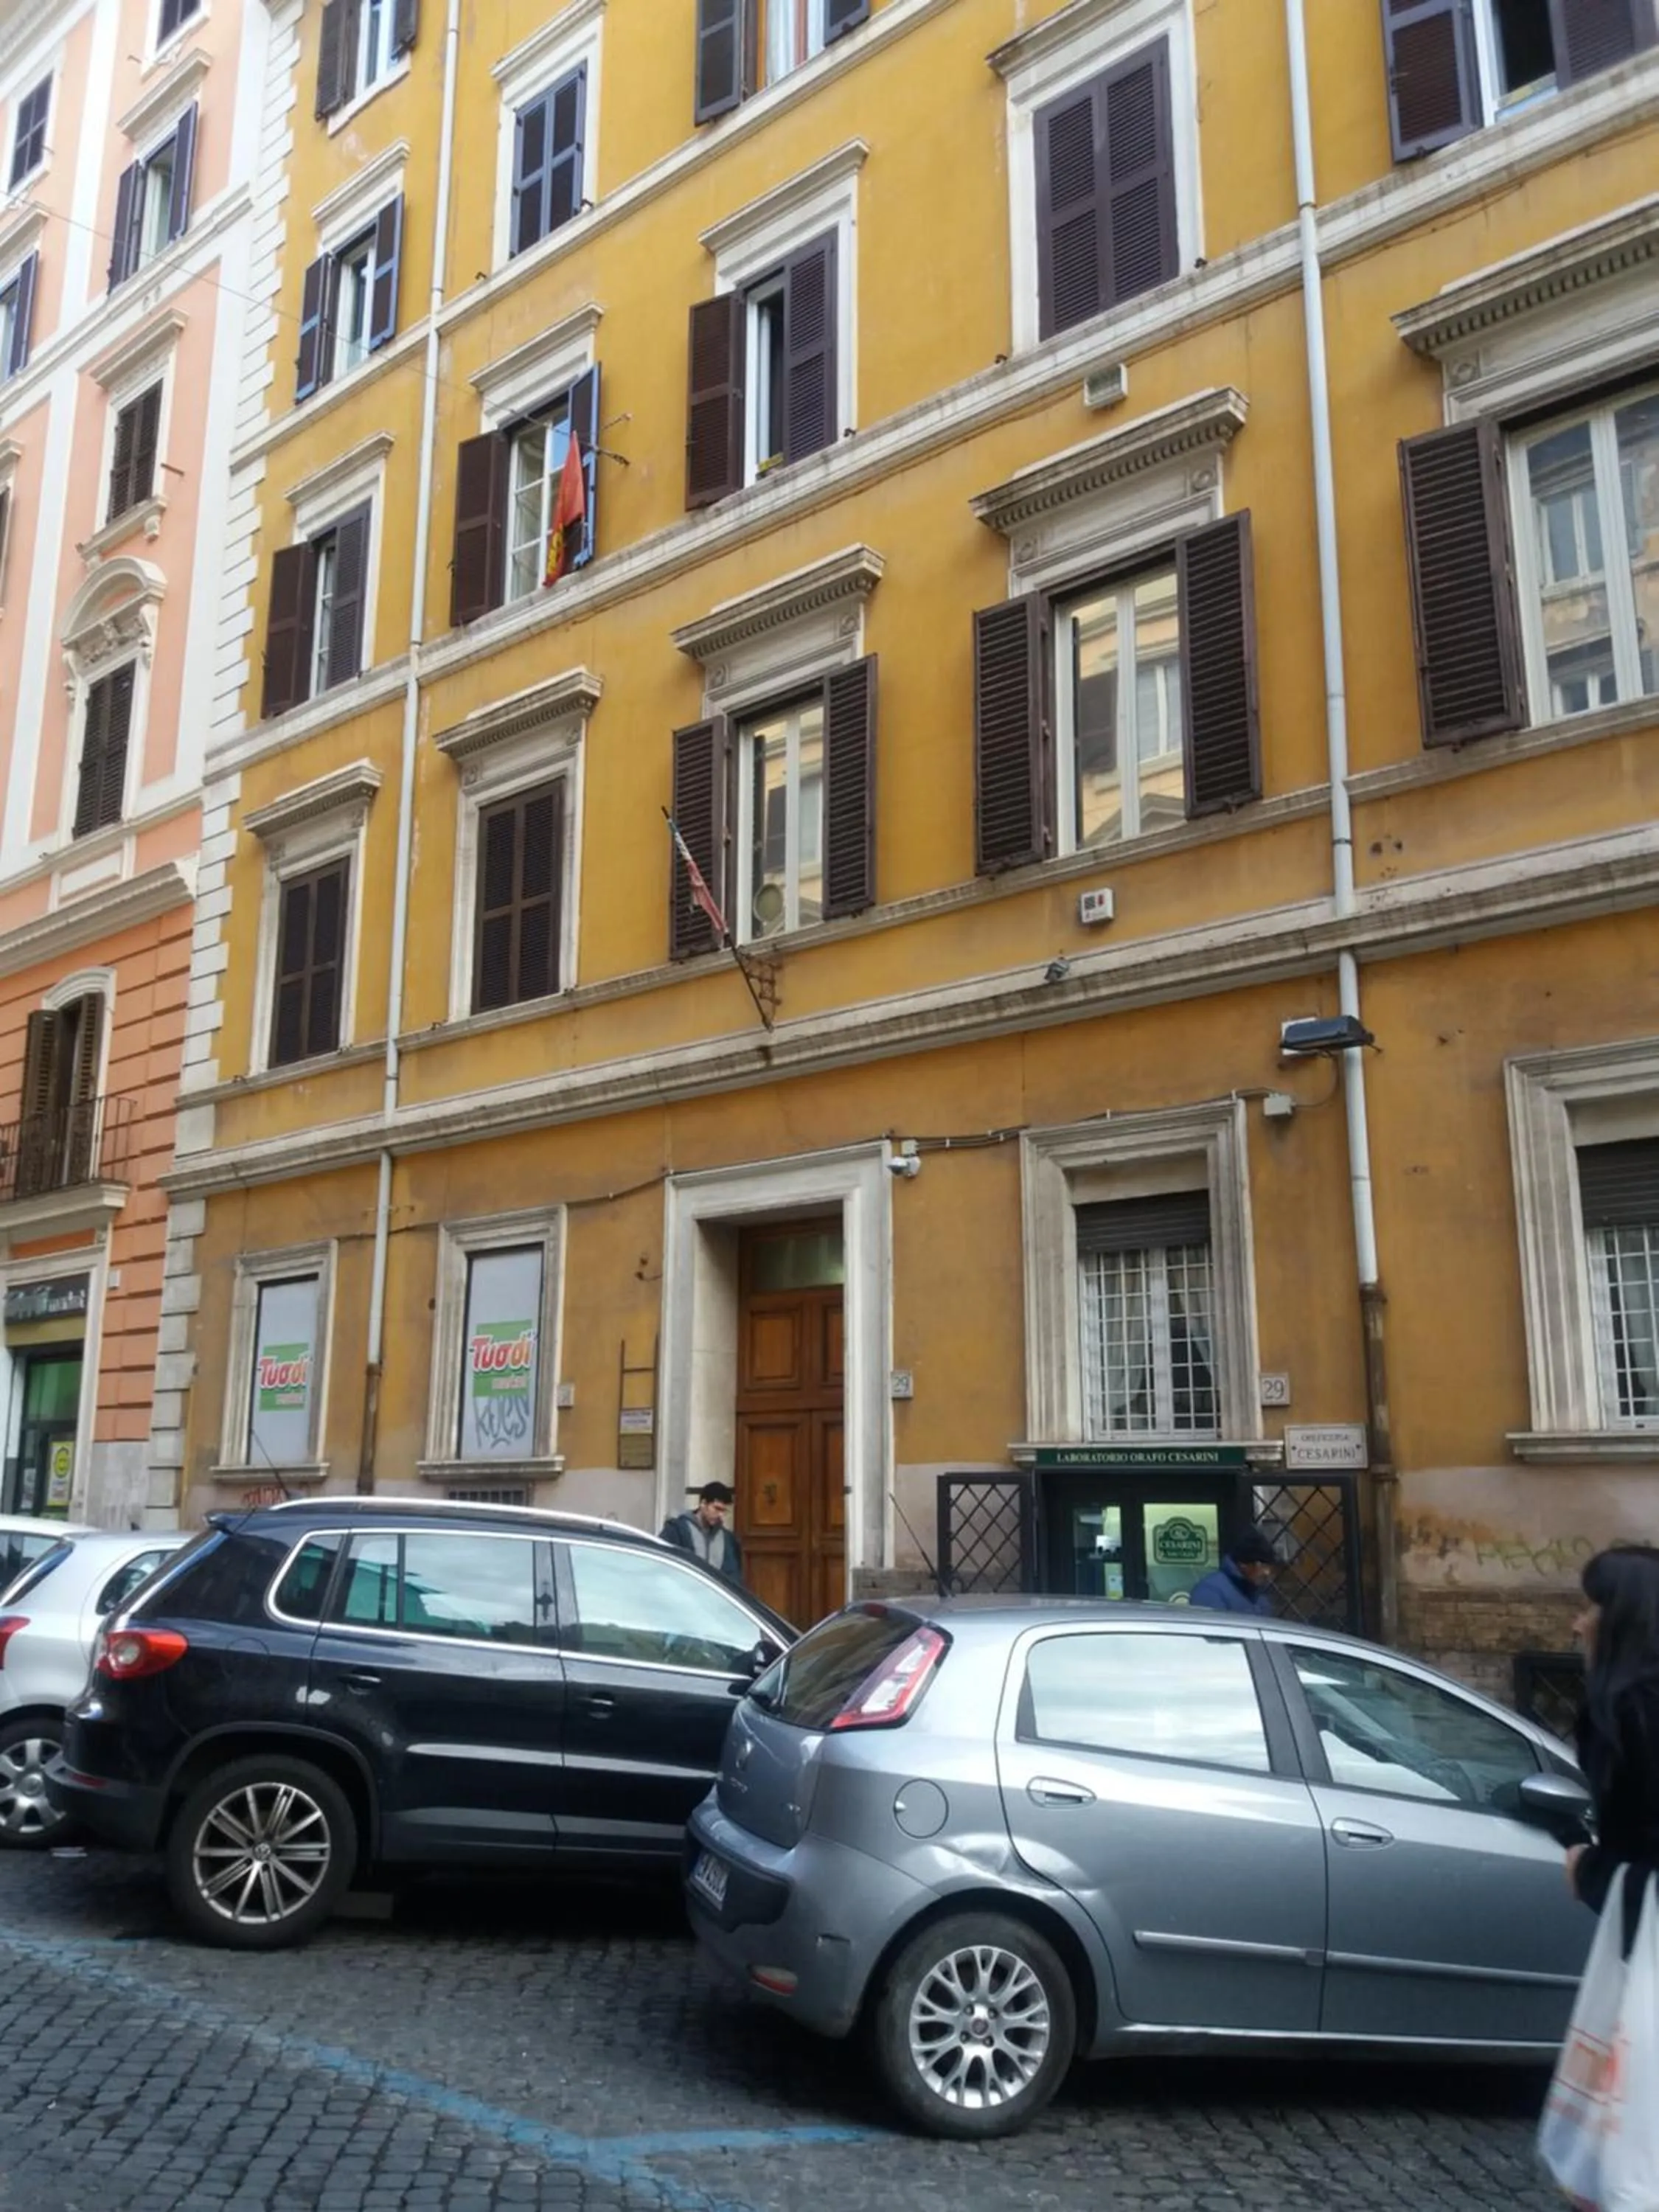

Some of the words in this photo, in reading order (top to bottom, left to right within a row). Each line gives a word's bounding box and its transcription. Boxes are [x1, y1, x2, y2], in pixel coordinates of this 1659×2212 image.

[1263, 1379, 1284, 1400] 29
[1056, 1452, 1128, 1464] LABORATORIO
[1129, 1451, 1166, 1463] ORAFO
[1168, 1451, 1219, 1463] CESARINI
[1297, 1446, 1356, 1461] CESARINI
